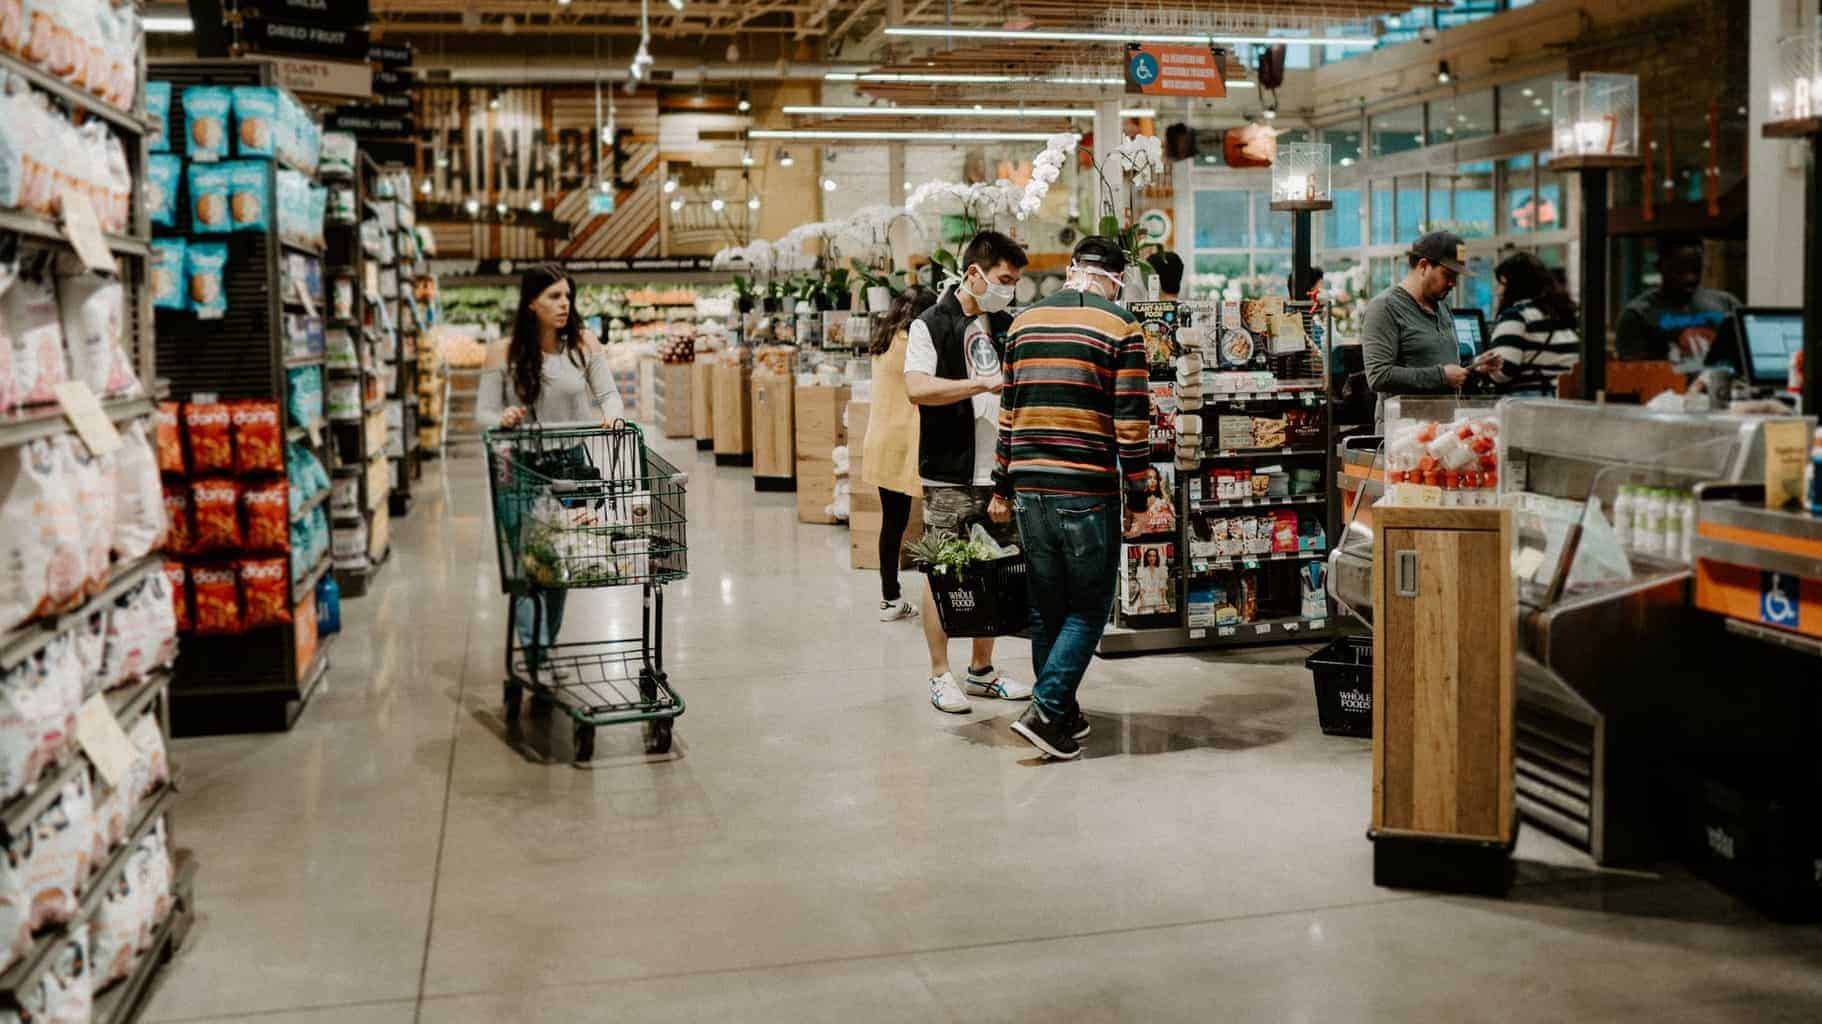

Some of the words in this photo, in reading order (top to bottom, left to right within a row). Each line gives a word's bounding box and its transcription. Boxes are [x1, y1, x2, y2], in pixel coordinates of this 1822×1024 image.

[267, 23, 307, 40] DRIED
[310, 28, 346, 44] FRUIT
[1132, 303, 1175, 313] PLANT-BASED
[948, 590, 974, 600] WHOLE
[951, 600, 975, 608] FOODS
[1341, 699, 1371, 710] FOODS
